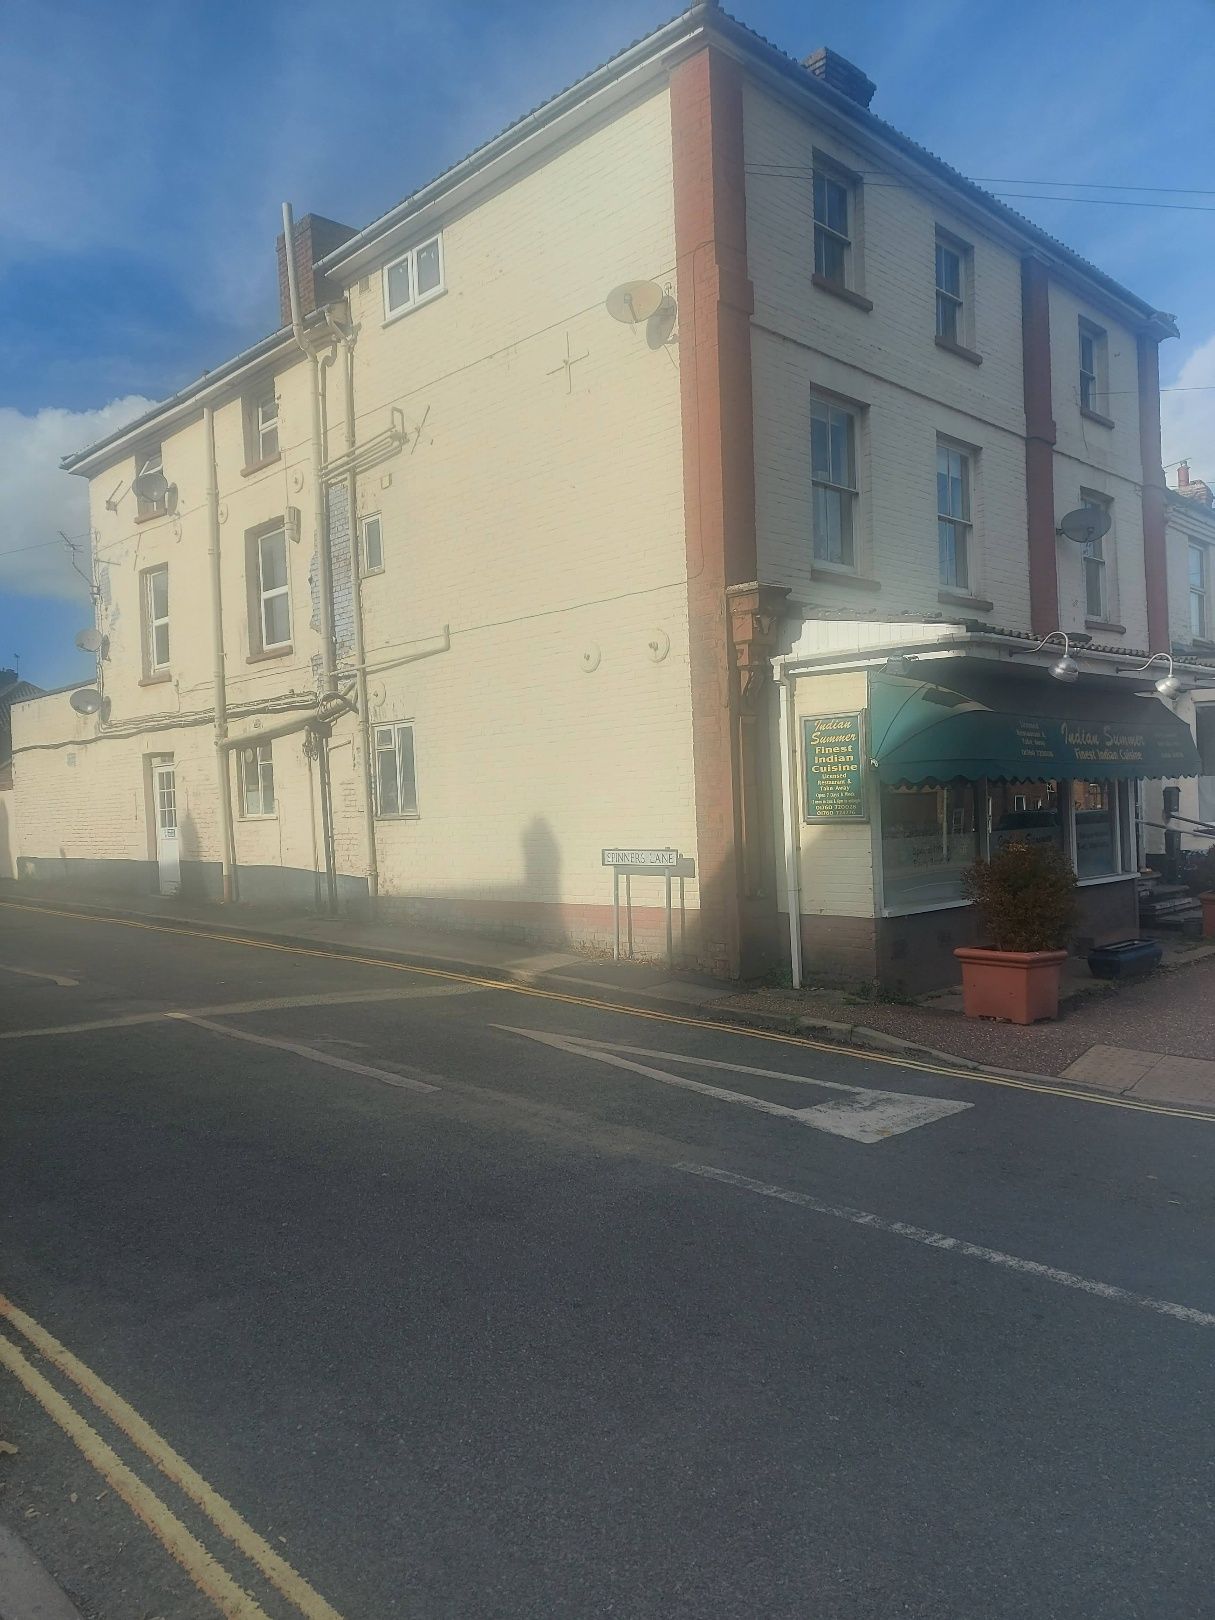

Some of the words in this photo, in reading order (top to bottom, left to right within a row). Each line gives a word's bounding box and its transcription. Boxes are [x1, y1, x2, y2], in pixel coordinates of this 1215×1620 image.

[814, 719, 852, 732] Indian
[810, 731, 857, 745] Summer
[1060, 721, 1100, 746] Indian
[1103, 725, 1145, 747] Summer
[815, 745, 853, 754] Finest
[1074, 748, 1096, 760] Finest
[1097, 748, 1118, 760] Indian
[1119, 749, 1143, 761] Cuisine
[814, 754, 854, 764] Indian
[811, 763, 858, 773] Cuisine
[606, 852, 646, 863] SPINNERS
[650, 852, 674, 864] LANE
